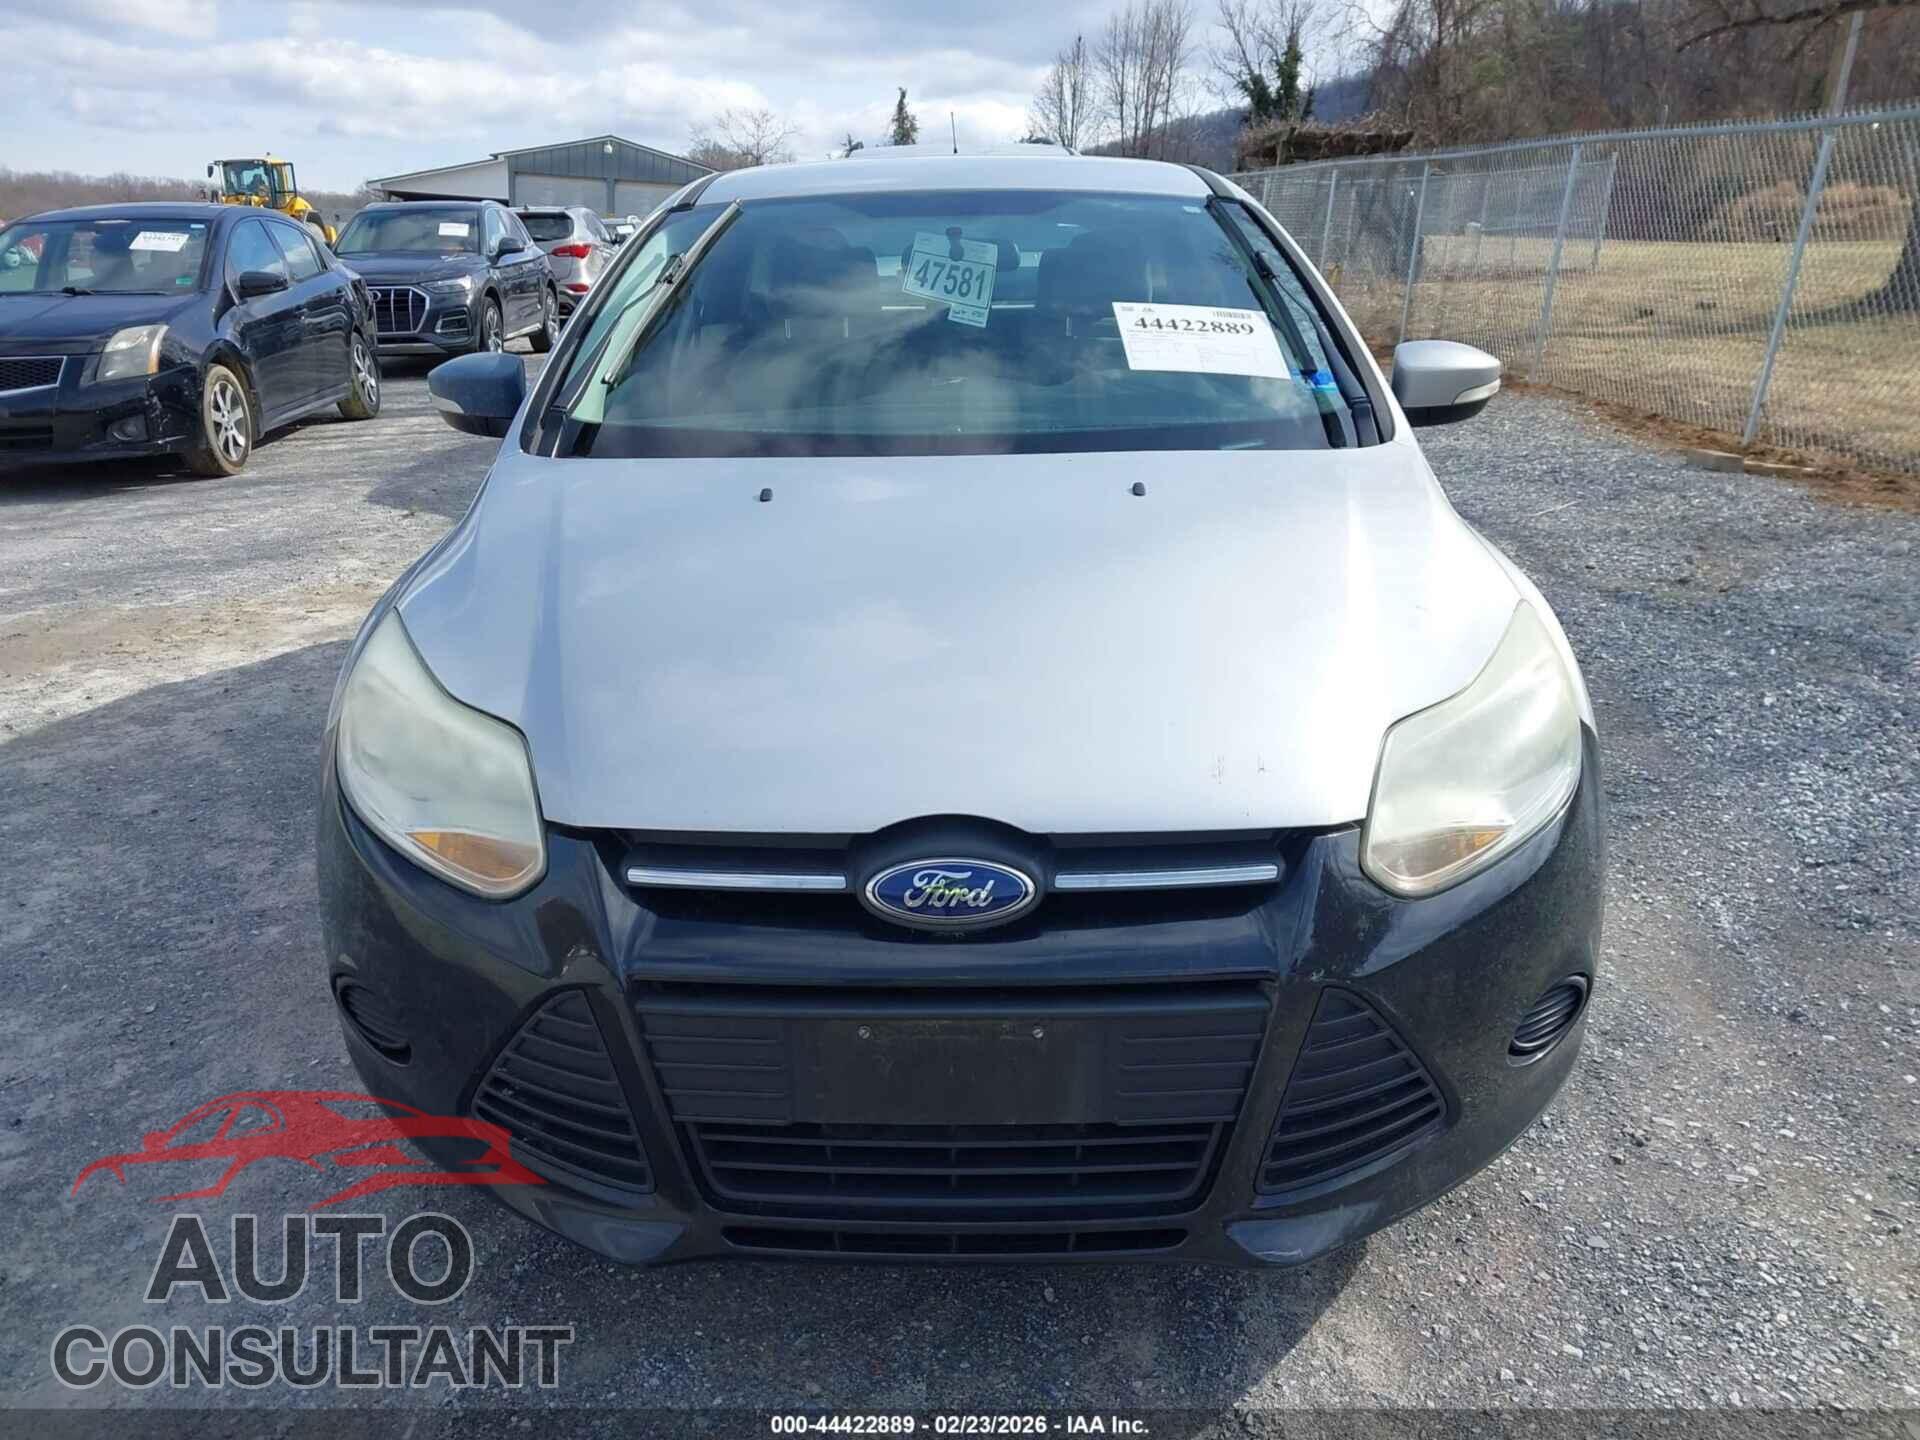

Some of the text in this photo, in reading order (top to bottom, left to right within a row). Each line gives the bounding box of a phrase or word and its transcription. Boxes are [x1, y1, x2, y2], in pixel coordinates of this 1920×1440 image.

[913, 259, 986, 301] 47581
[1134, 317, 1255, 335] 44422889
[903, 869, 995, 908] Ford
